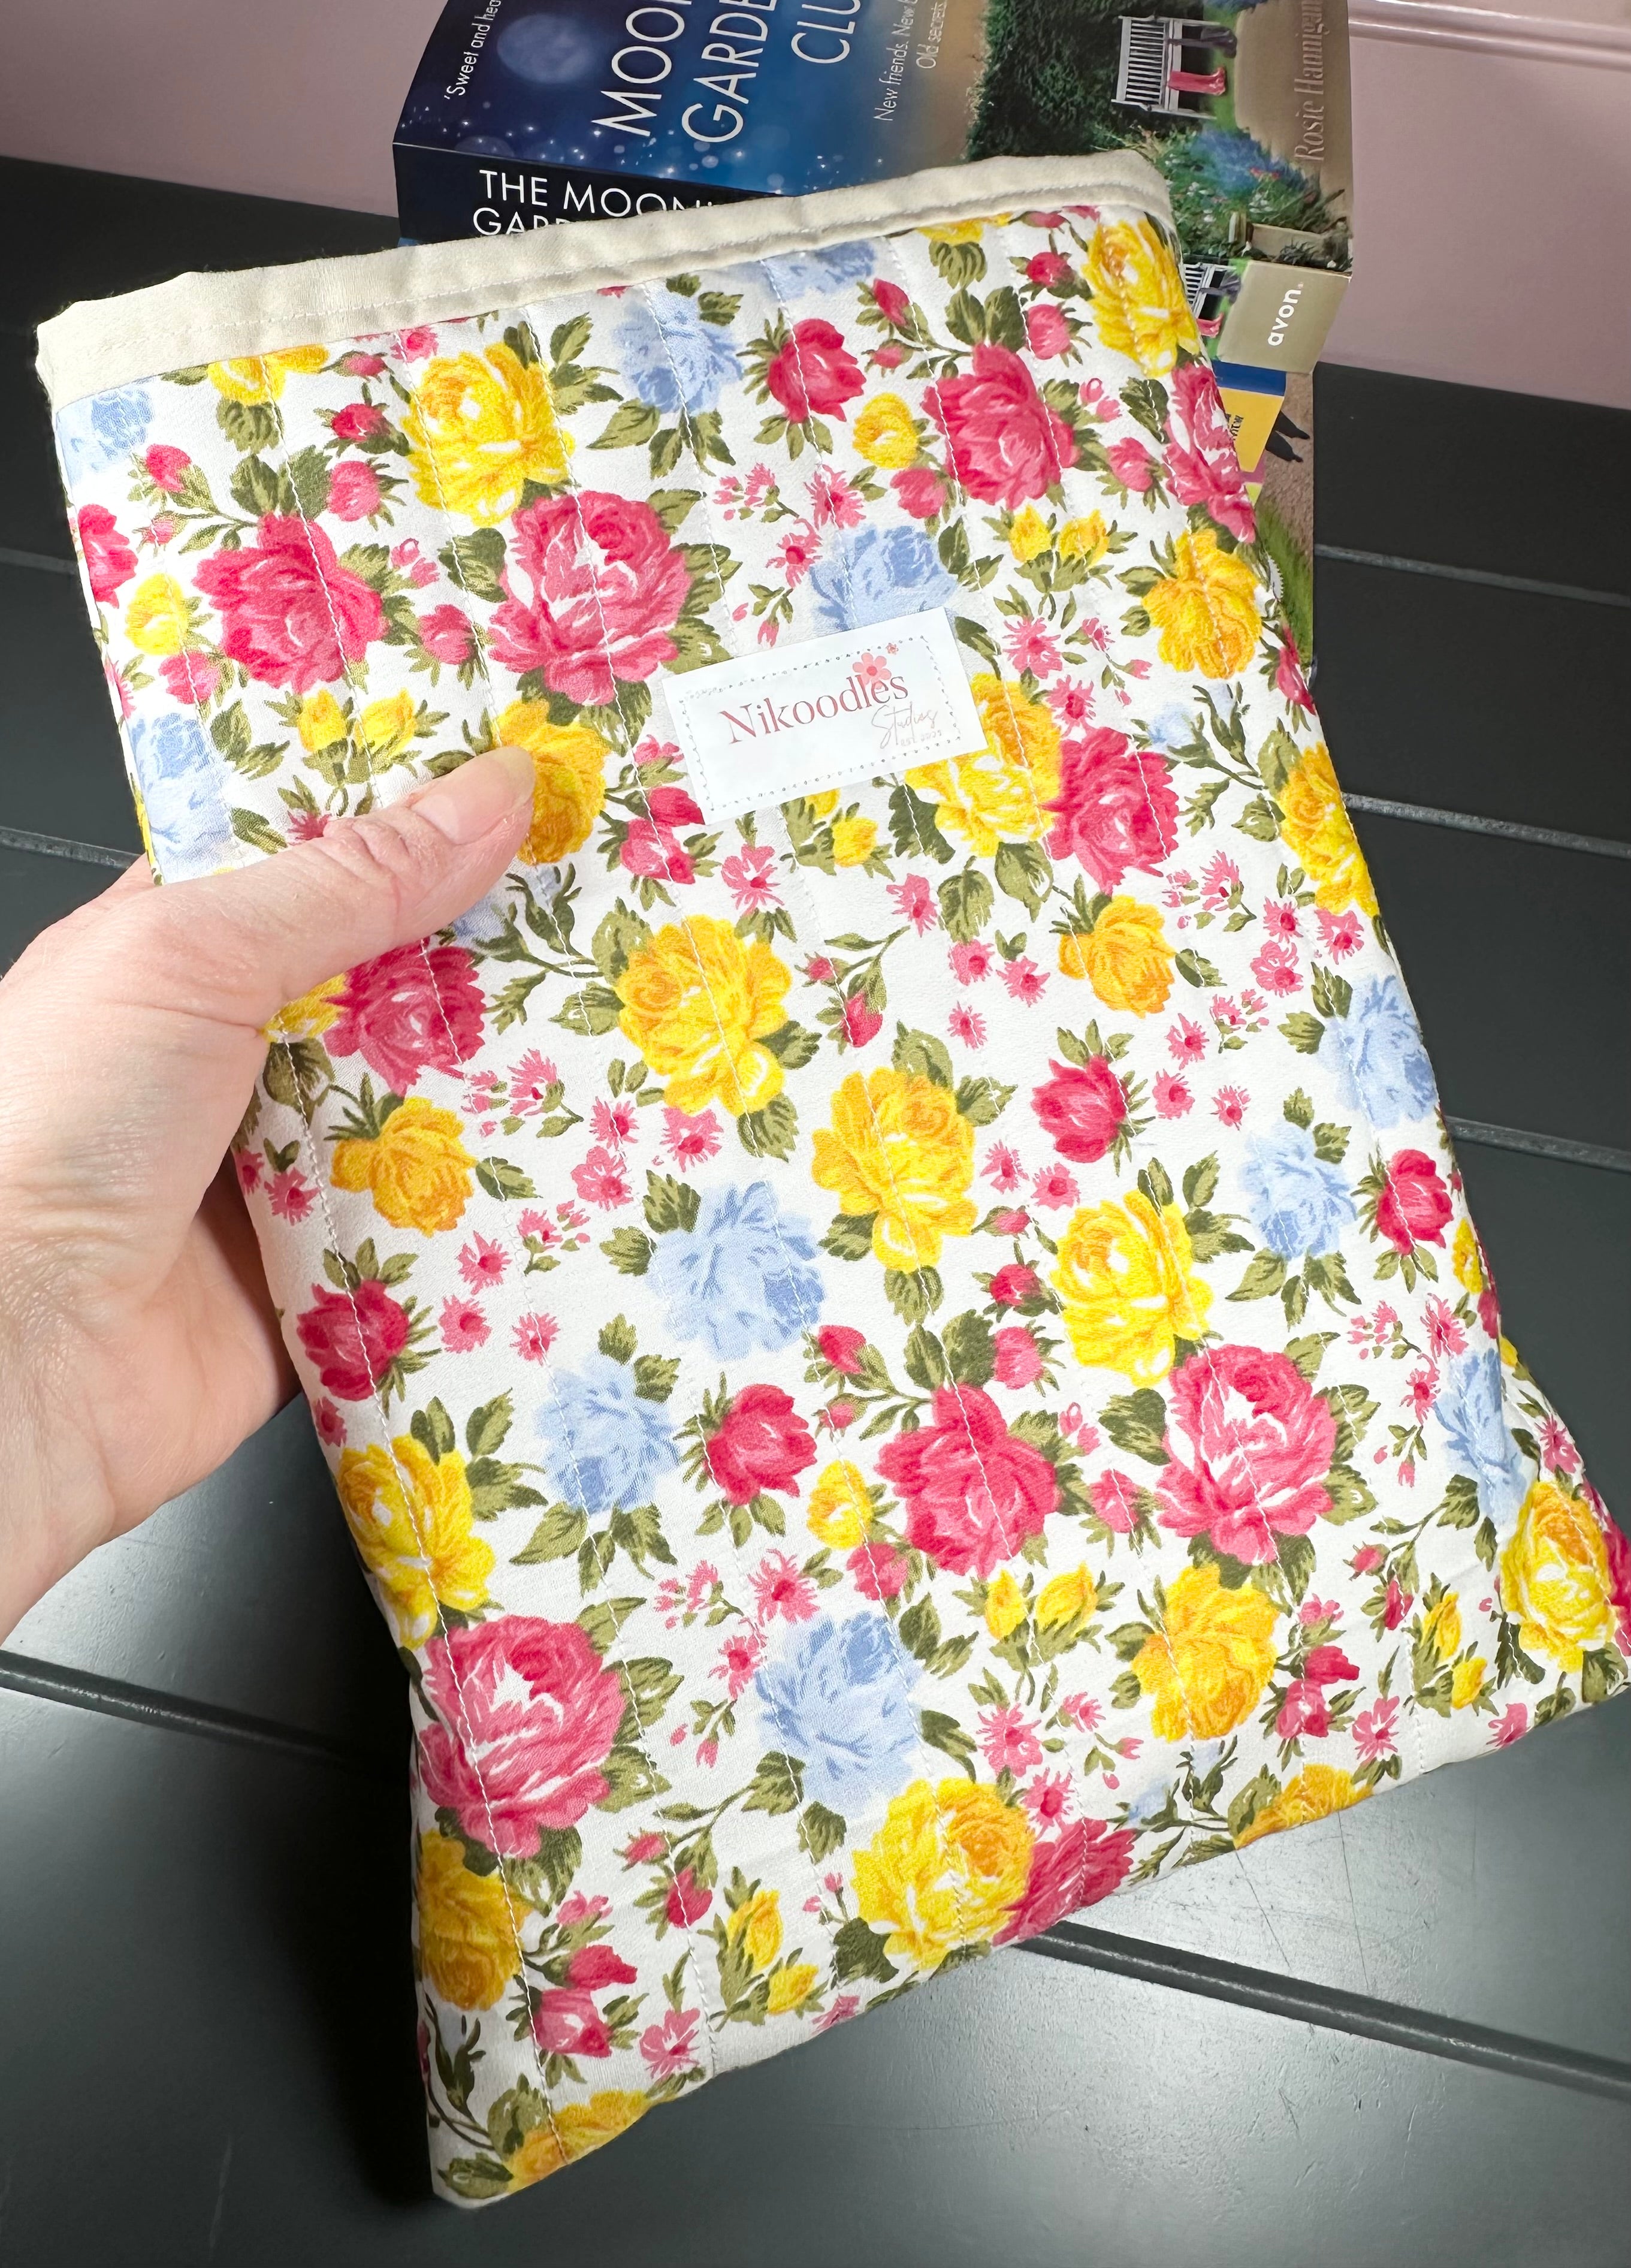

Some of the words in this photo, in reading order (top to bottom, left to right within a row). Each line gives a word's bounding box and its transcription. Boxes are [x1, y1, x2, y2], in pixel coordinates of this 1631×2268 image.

[471, 23, 490, 48] and
[873, 88, 898, 121] New
[892, 5, 916, 37] New
[916, 44, 940, 69] Old
[591, 0, 691, 137] MOO
[1294, 101, 1325, 161] Rosie
[479, 170, 548, 207] THE
[563, 181, 712, 218] MOO
[718, 674, 908, 744] Nikoodles
